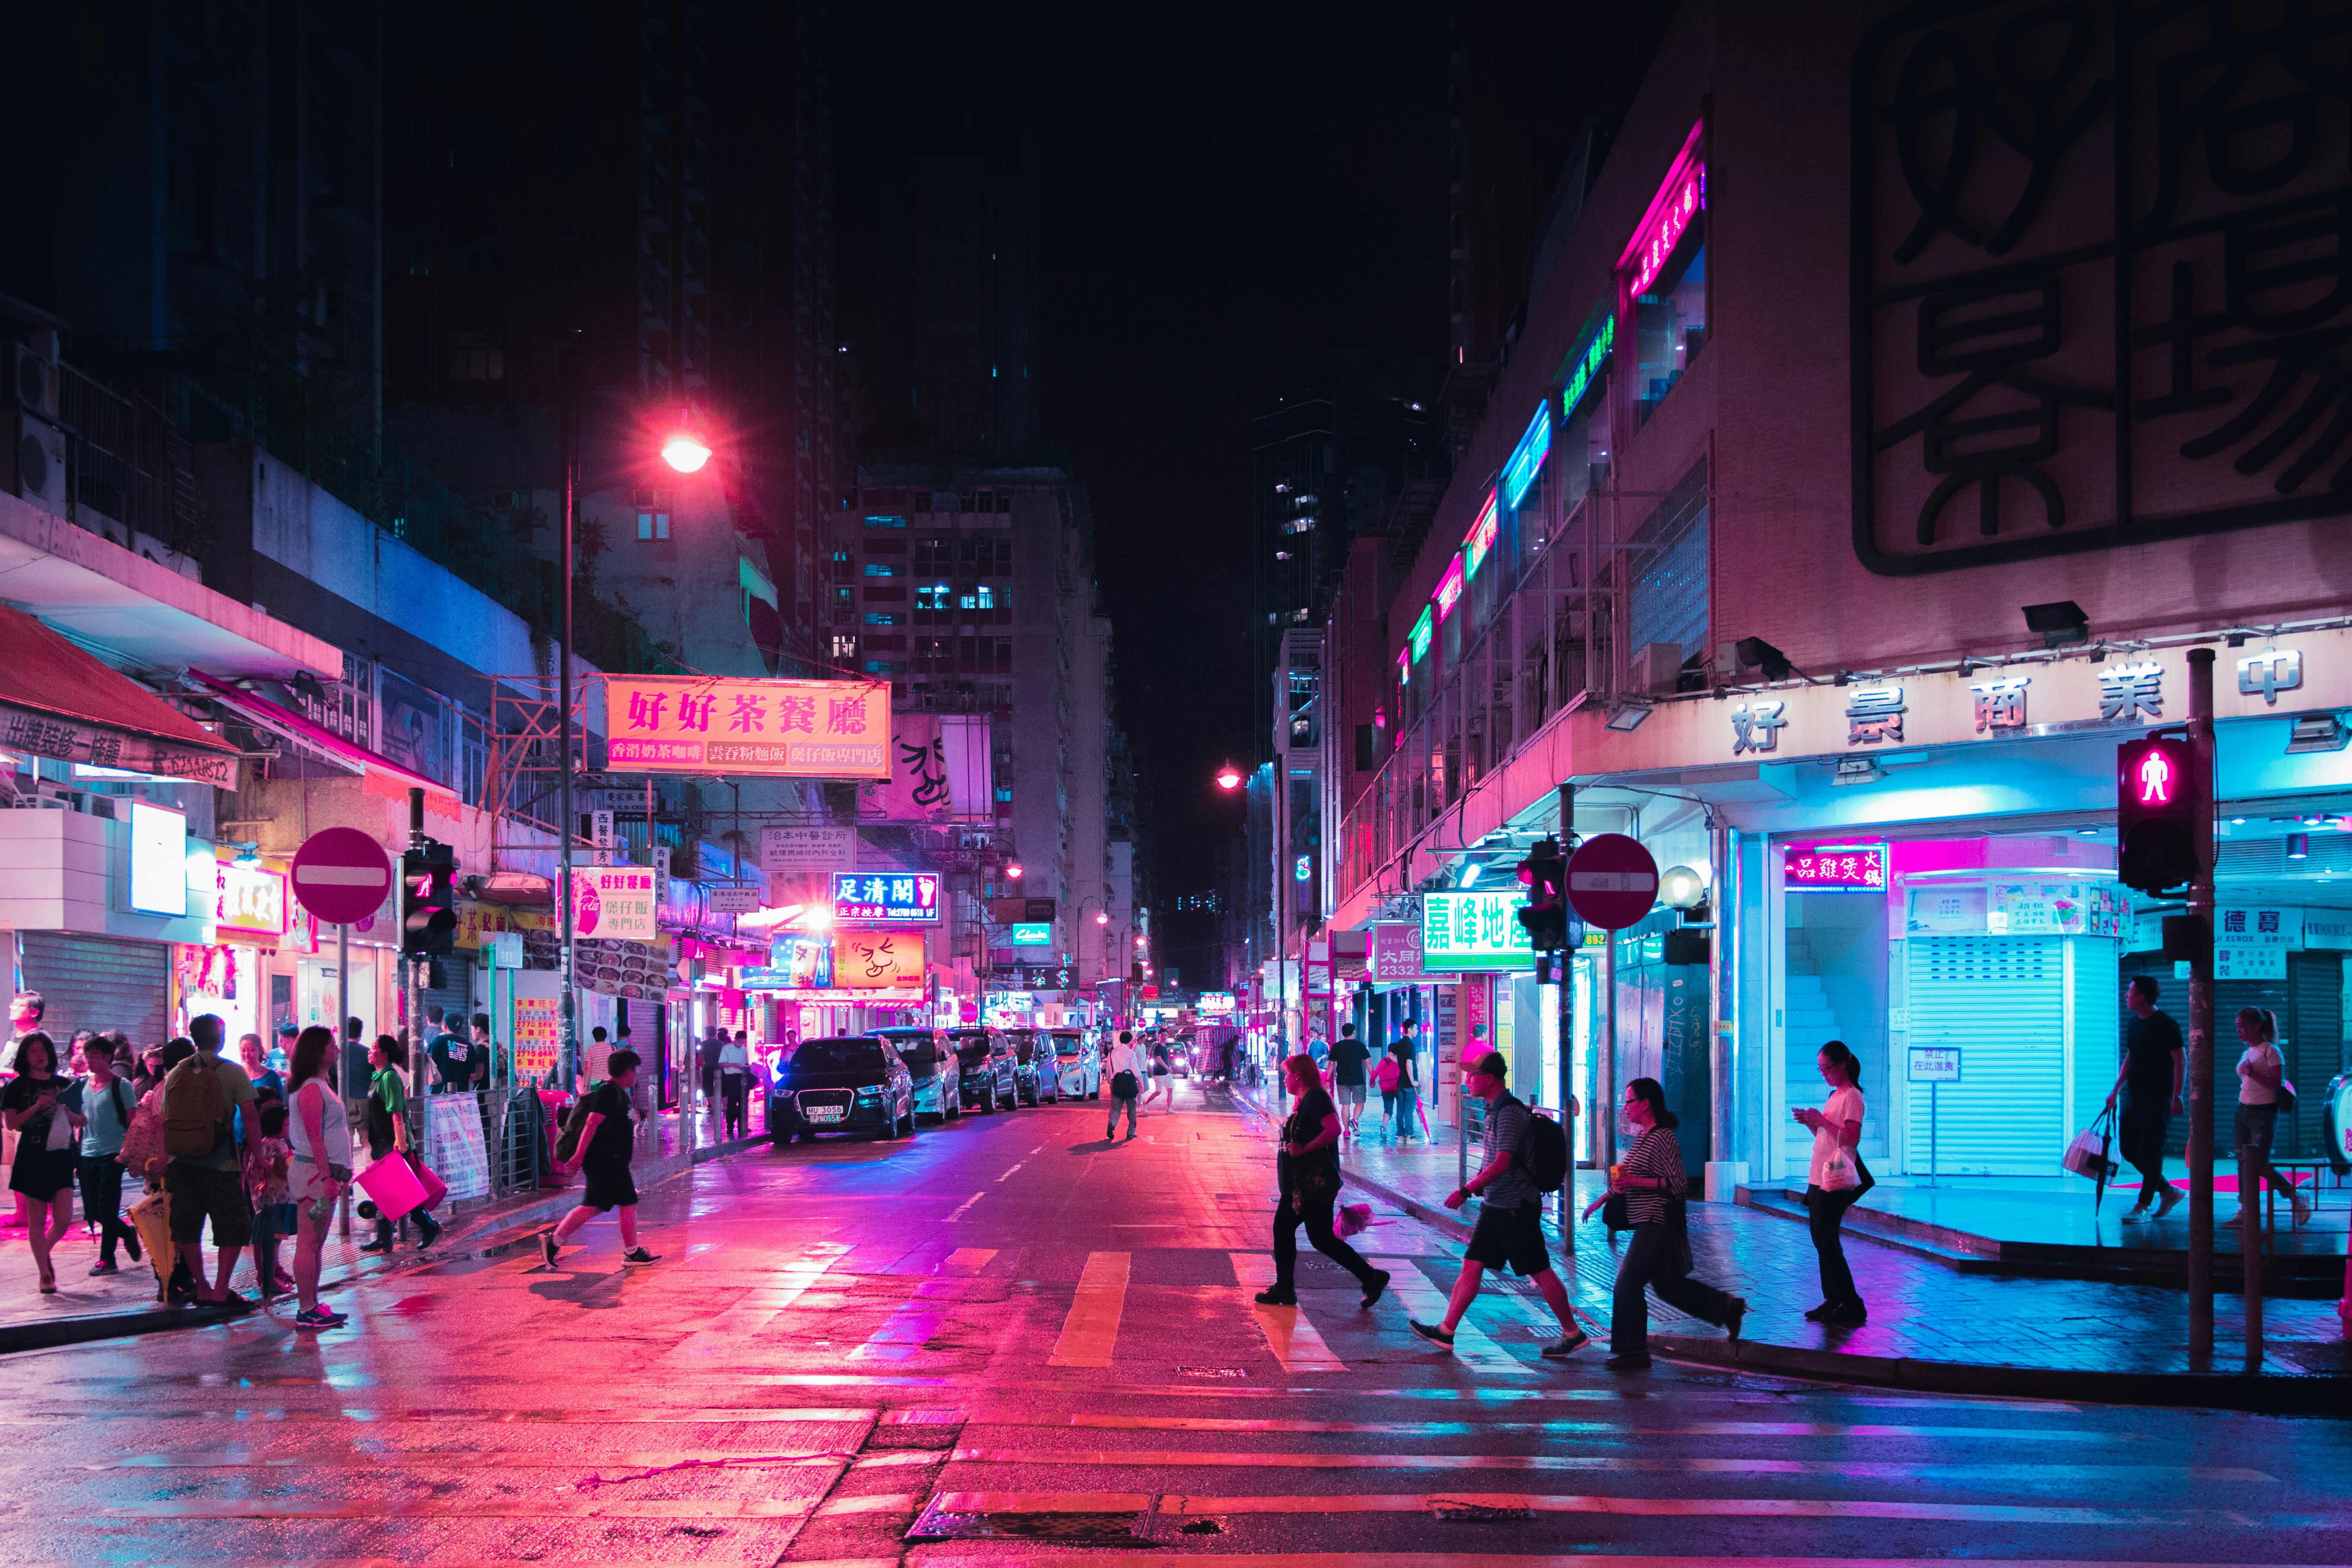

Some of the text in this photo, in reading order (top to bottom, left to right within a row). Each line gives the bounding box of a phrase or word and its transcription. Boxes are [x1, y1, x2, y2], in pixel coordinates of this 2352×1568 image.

[628, 691, 866, 735] 好好茶餐廳
[611, 743, 882, 763] 香滑奶茶咖啡 雲吞粉麵飯 煲仔飯專門店
[769, 831, 847, 840] 治本中醫診所
[601, 875, 651, 889] 好好餐廳
[836, 877, 914, 905] 足清閣
[605, 901, 648, 914] 煲仔飯
[838, 906, 884, 917] 正宗按摩
[608, 918, 646, 930] 專門店
[1427, 897, 1532, 949] 嘉峰地產
[2225, 911, 2280, 933] 德寶
[1381, 966, 1414, 975] 2332
[1914, 1061, 1954, 1071] 在此進食
